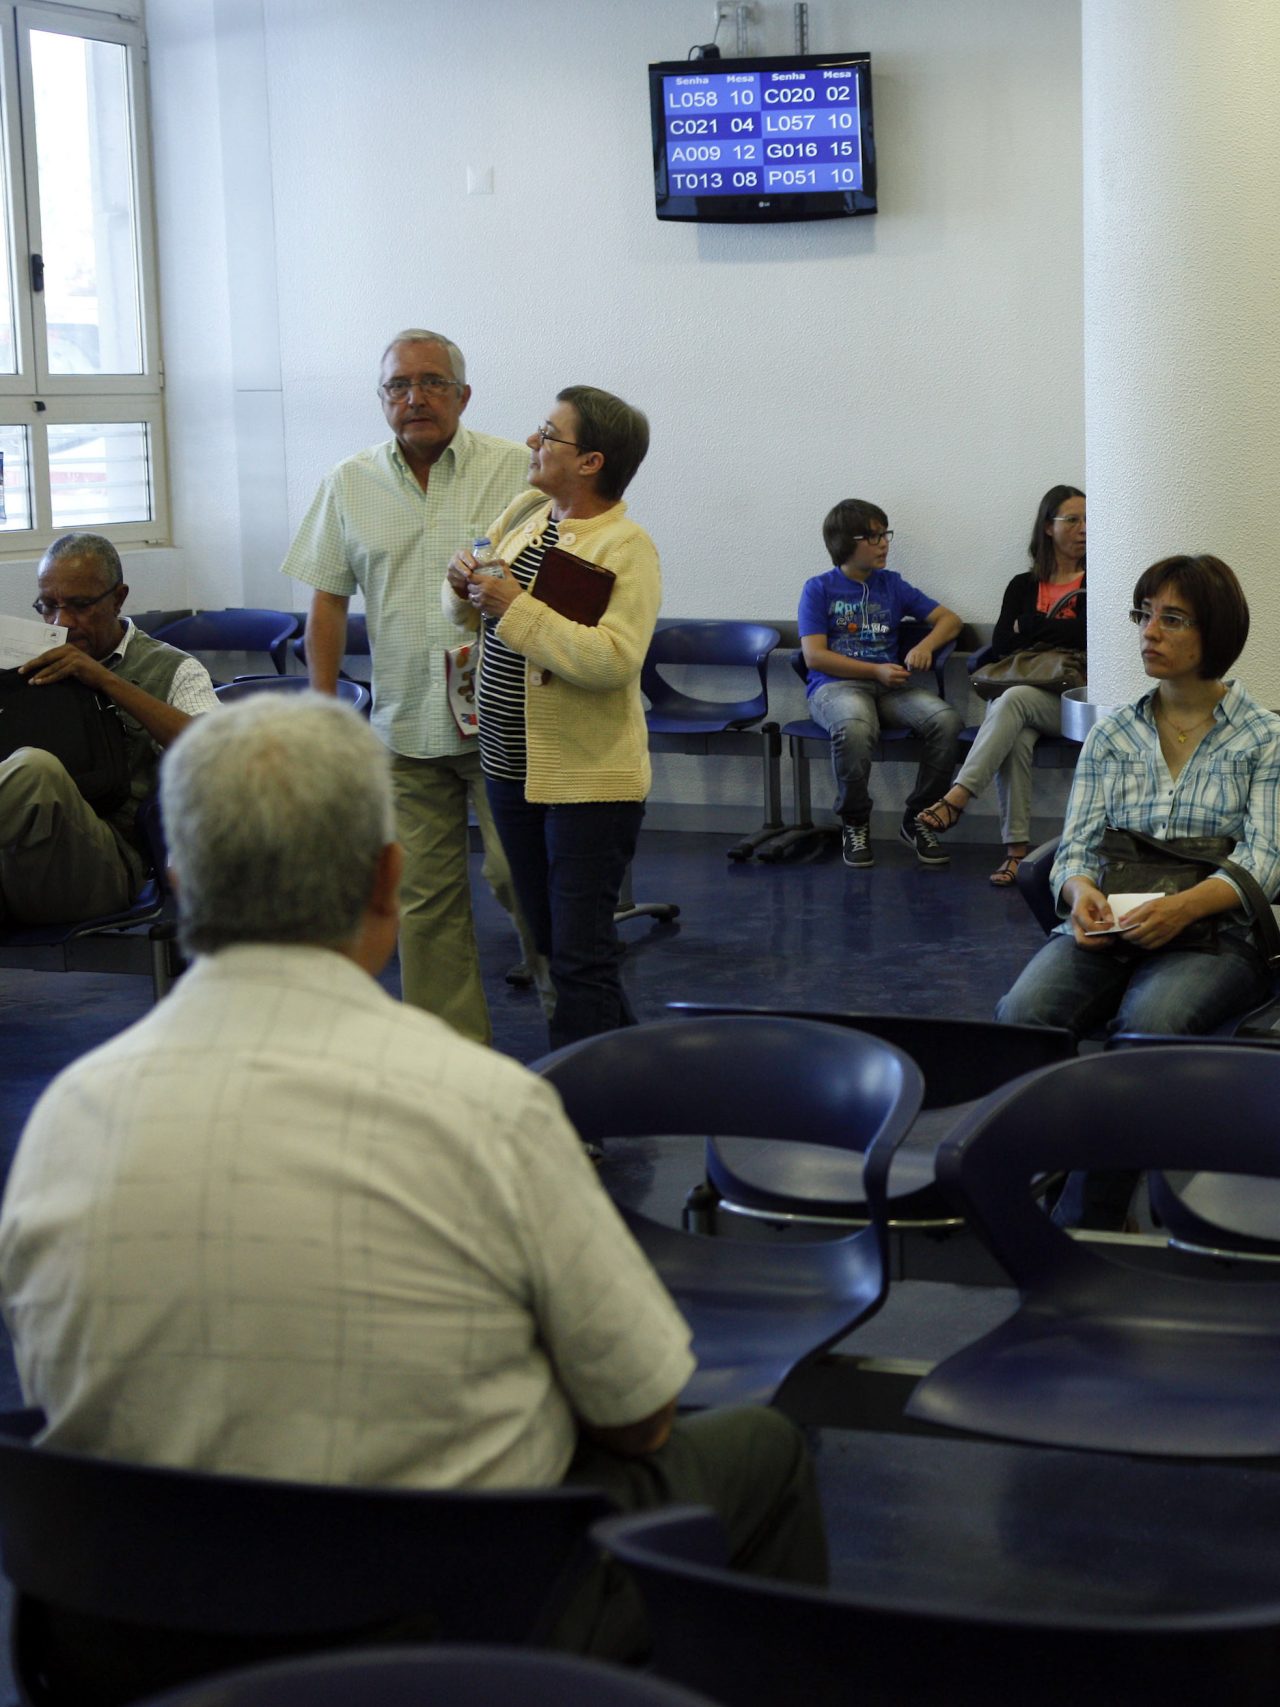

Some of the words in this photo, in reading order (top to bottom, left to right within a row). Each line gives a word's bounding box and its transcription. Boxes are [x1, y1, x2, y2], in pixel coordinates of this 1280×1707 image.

[676, 77, 709, 85] Senha
[727, 75, 754, 83] Mesa
[772, 73, 805, 81] Senha
[824, 71, 851, 79] Mesa
[670, 91, 718, 108] L058
[731, 90, 753, 105] 10
[764, 88, 815, 103] C020
[827, 86, 850, 101] 02
[670, 119, 718, 134] C021
[731, 118, 753, 132] 04
[767, 115, 815, 131] L057
[829, 114, 852, 128] 10
[672, 146, 720, 161] A009
[734, 145, 755, 160] 12
[767, 143, 817, 158] G016
[831, 142, 852, 156] 15
[673, 173, 722, 188] T013
[733, 172, 757, 187] 08
[769, 170, 816, 185] P051
[832, 169, 853, 183] 10
